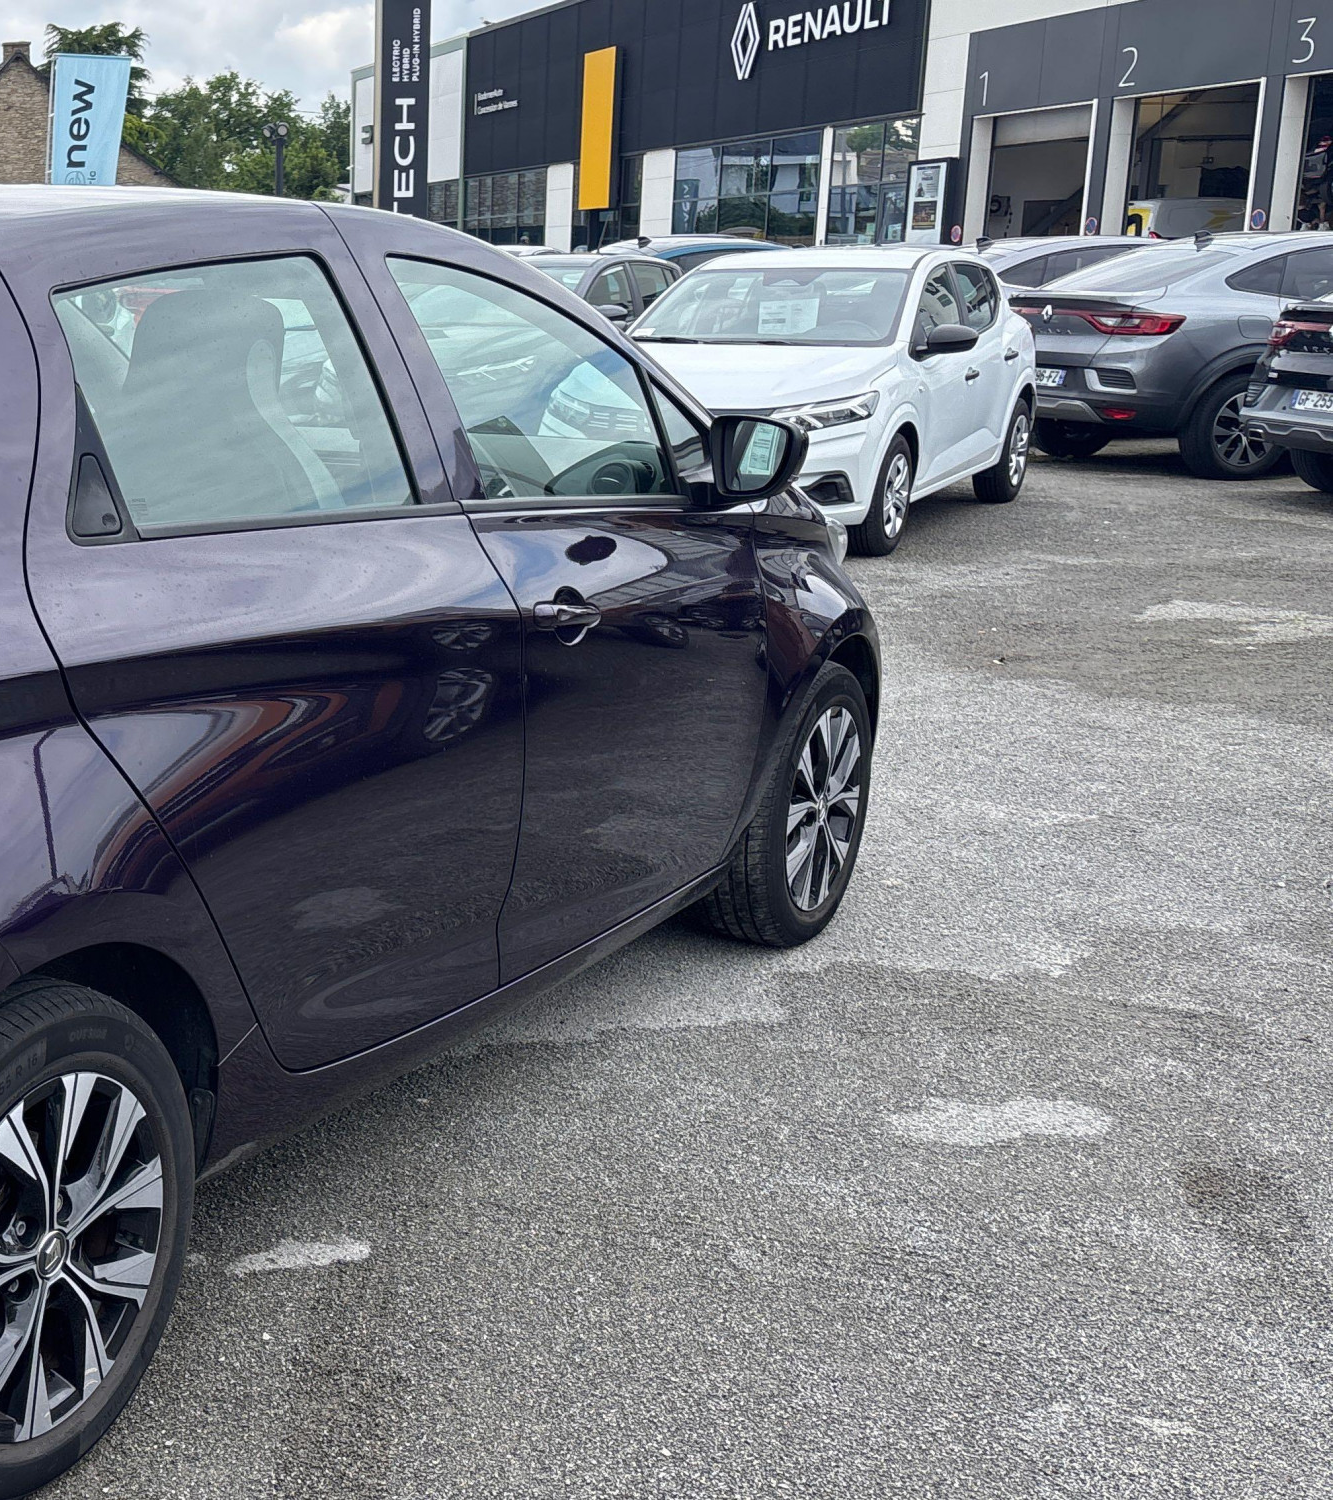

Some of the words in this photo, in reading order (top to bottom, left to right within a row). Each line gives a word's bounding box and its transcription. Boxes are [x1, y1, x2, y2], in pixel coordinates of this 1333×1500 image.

[413, 8, 421, 42] HYBRID
[768, 0, 891, 51] RENAULT
[1292, 17, 1317, 64] 3
[392, 40, 400, 82] ELECTRIC
[402, 48, 410, 82] HYBRID
[412, 44, 420, 82] PLUG-IN
[1118, 46, 1138, 87] 2
[979, 71, 989, 106] 1
